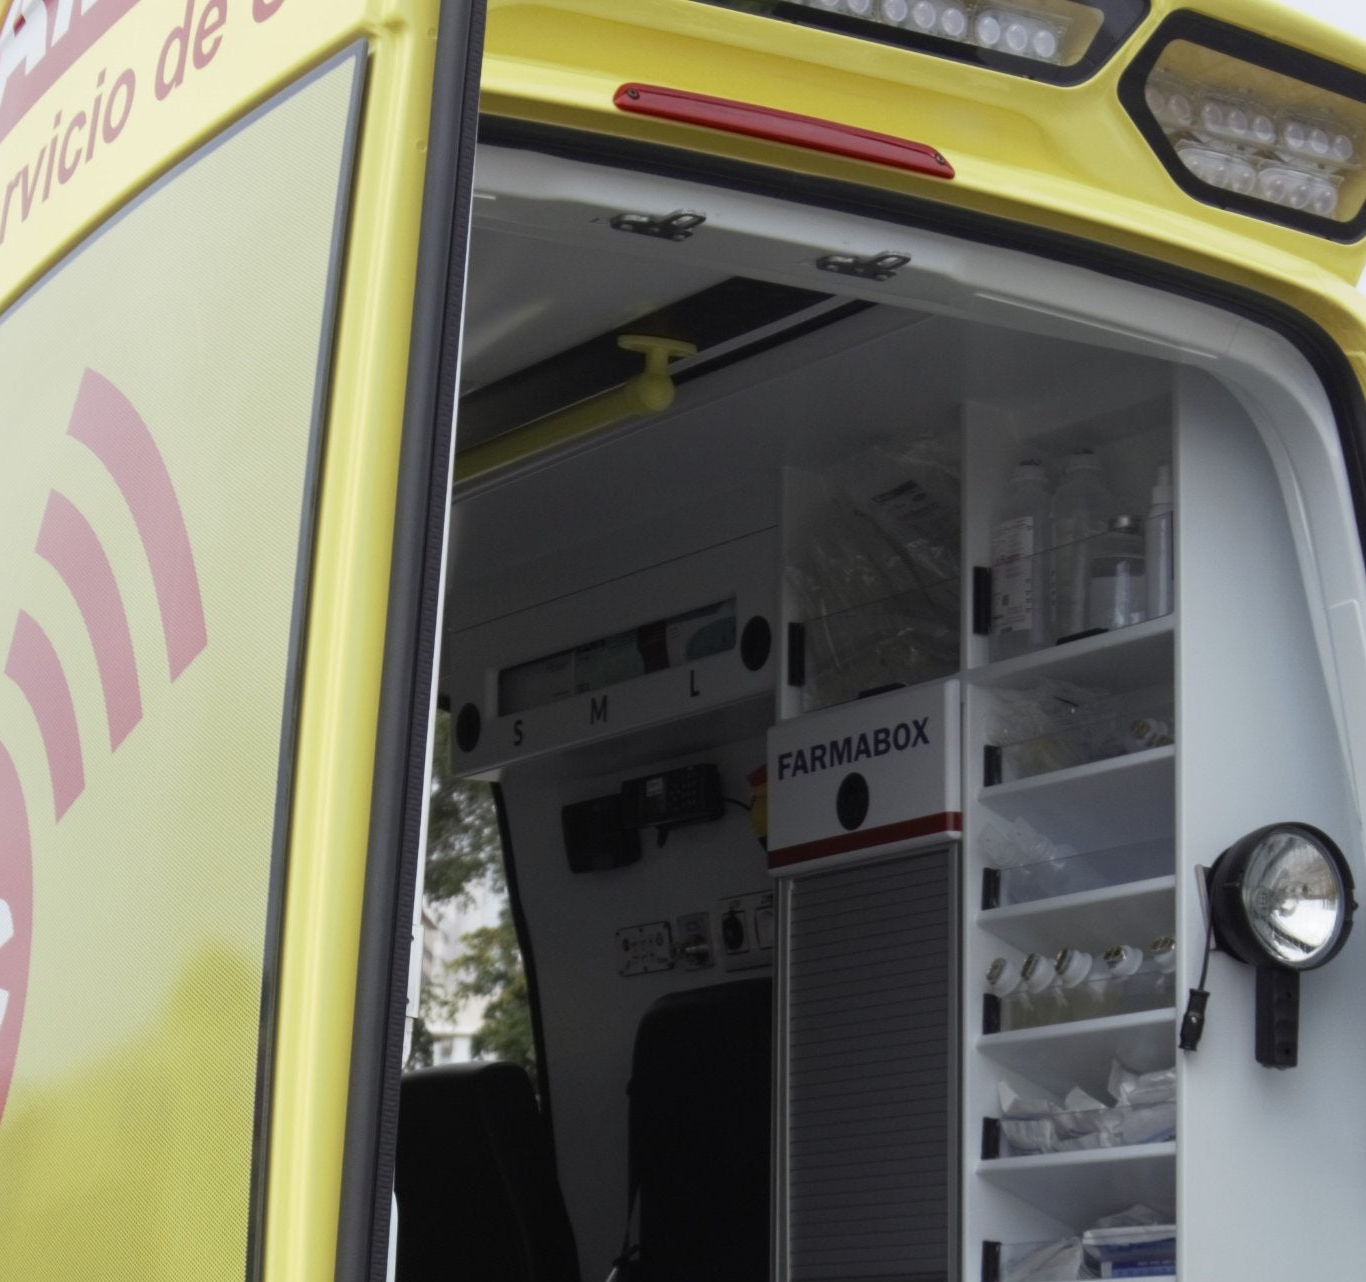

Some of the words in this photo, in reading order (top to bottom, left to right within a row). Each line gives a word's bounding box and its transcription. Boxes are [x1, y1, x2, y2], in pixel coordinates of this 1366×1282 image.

[154, 0, 228, 101] de
[513, 719, 524, 747] S
[590, 695, 608, 725] M
[689, 669, 701, 697] L
[777, 717, 931, 781] FARMABOX
